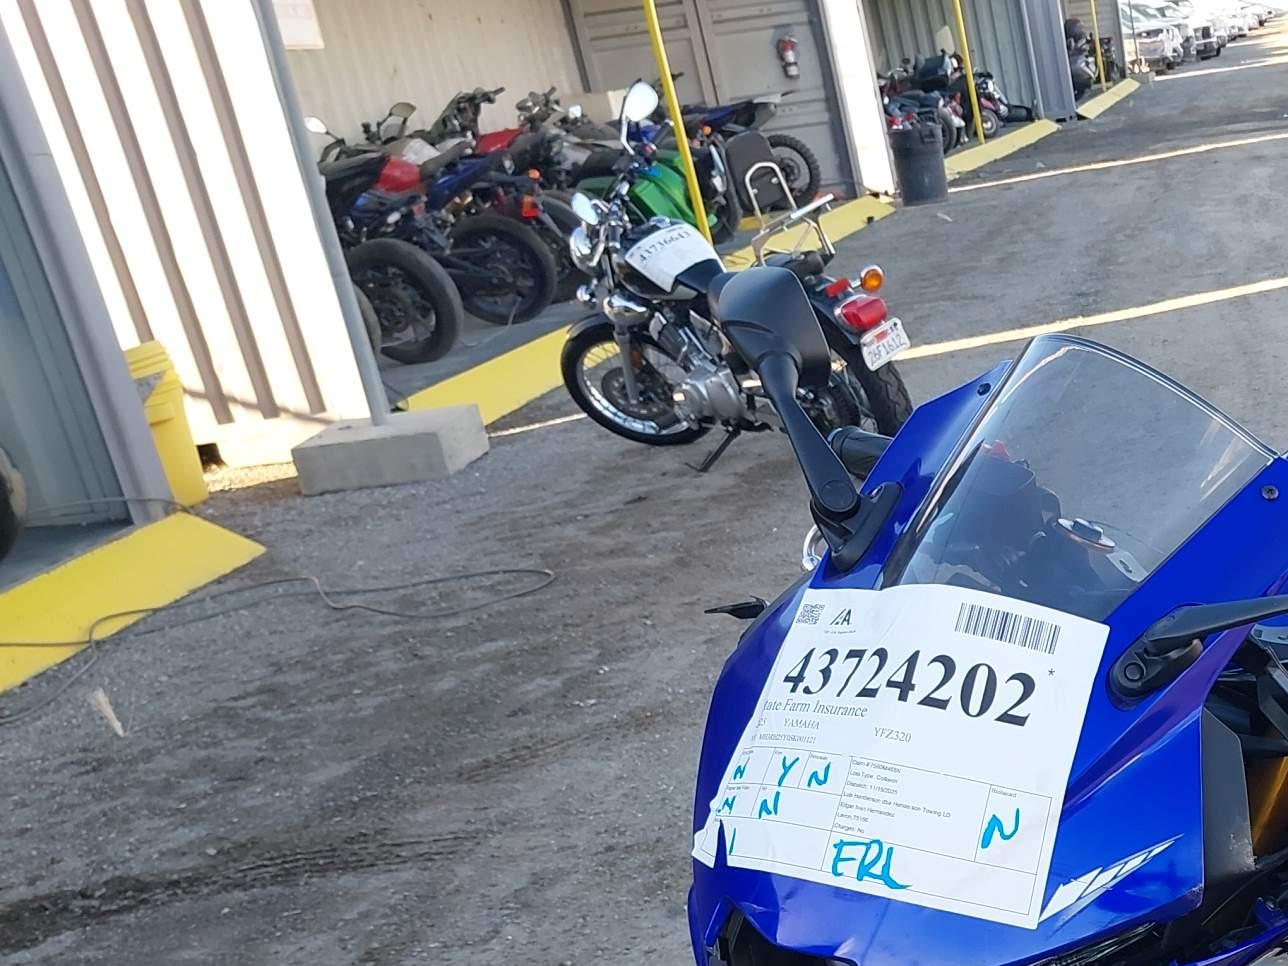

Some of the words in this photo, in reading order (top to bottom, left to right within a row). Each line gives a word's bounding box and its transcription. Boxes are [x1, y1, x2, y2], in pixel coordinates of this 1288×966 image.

[782, 647, 1036, 727] 43724202
[763, 700, 782, 711] tate
[783, 699, 811, 713] Farm
[813, 700, 868, 718] Insurance
[783, 718, 820, 730] YAMAHA
[874, 727, 912, 743] YFZ320
[778, 756, 799, 787] Y
[807, 761, 832, 788] N
[981, 807, 1020, 849] N
